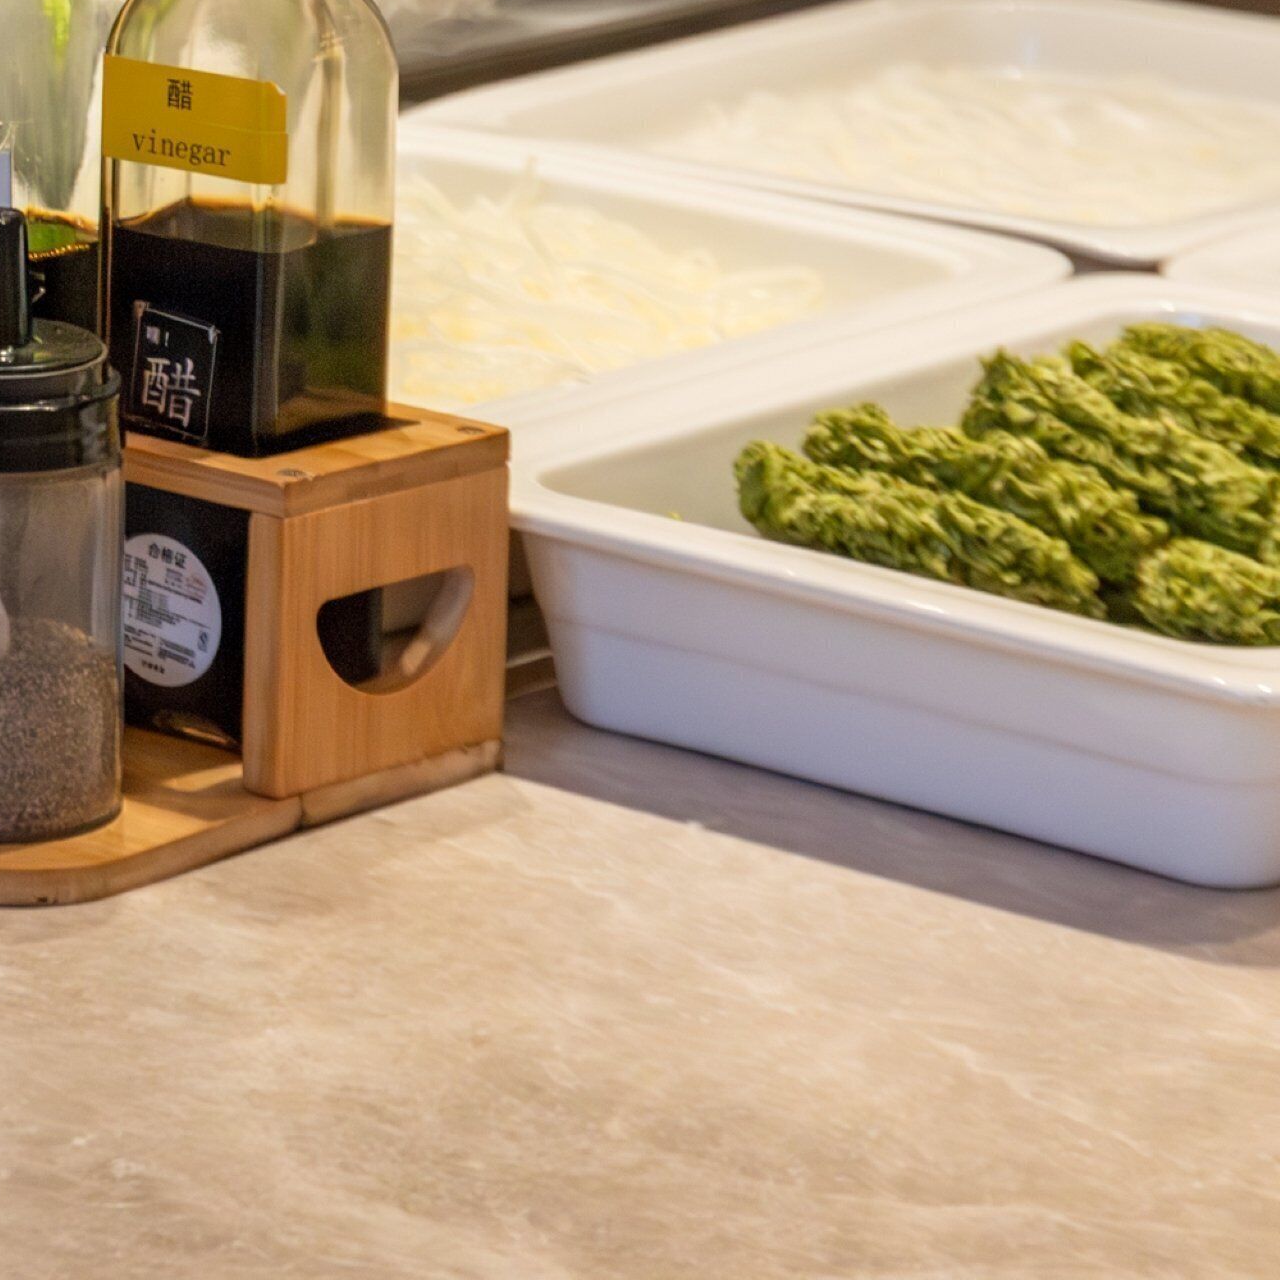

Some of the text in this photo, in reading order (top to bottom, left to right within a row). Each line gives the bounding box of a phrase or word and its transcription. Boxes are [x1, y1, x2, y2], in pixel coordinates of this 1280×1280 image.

[167, 78, 193, 111] 醋
[132, 129, 231, 167] vinegar
[142, 357, 201, 428] 醋
